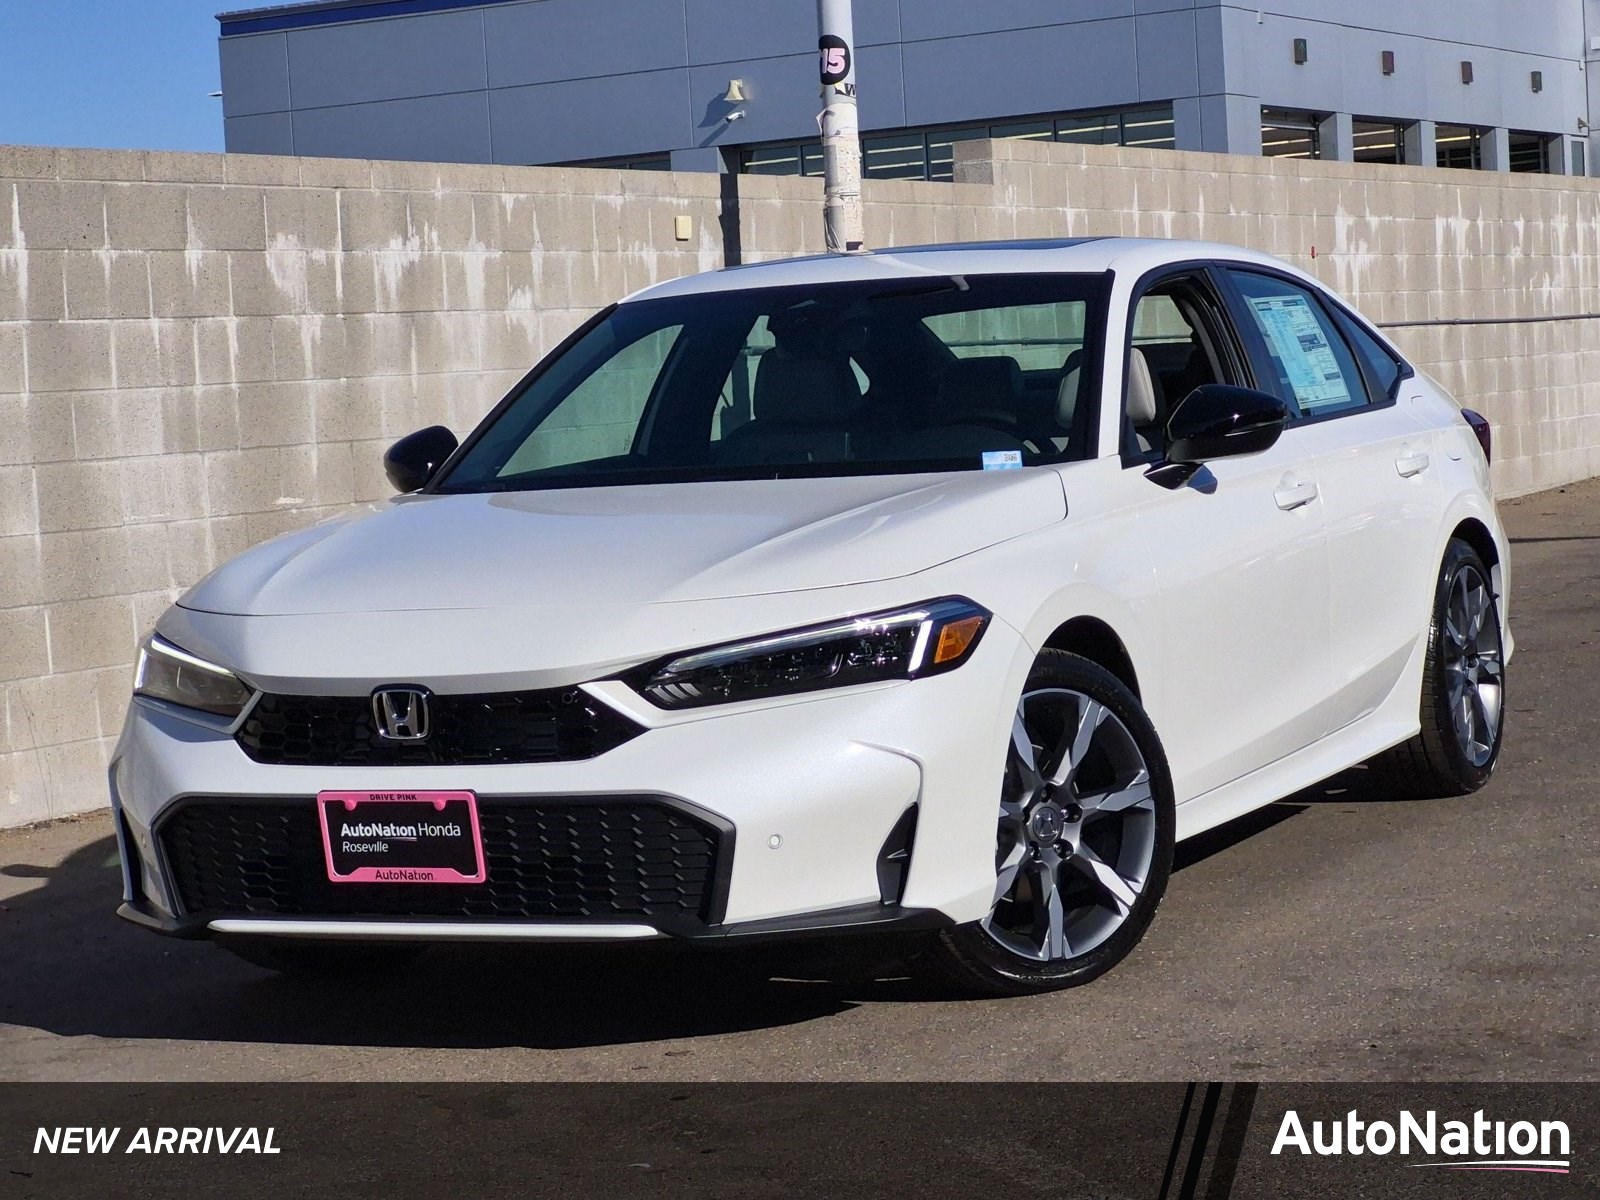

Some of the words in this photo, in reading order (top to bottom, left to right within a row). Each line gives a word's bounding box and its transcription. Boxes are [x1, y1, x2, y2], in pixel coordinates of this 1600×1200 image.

[369, 793, 395, 801] DRIVE
[397, 793, 418, 801] PINK
[340, 823, 417, 837] AutoNation
[418, 822, 461, 837] Honda
[342, 841, 389, 853] Roseville
[375, 870, 434, 881] AutoNation
